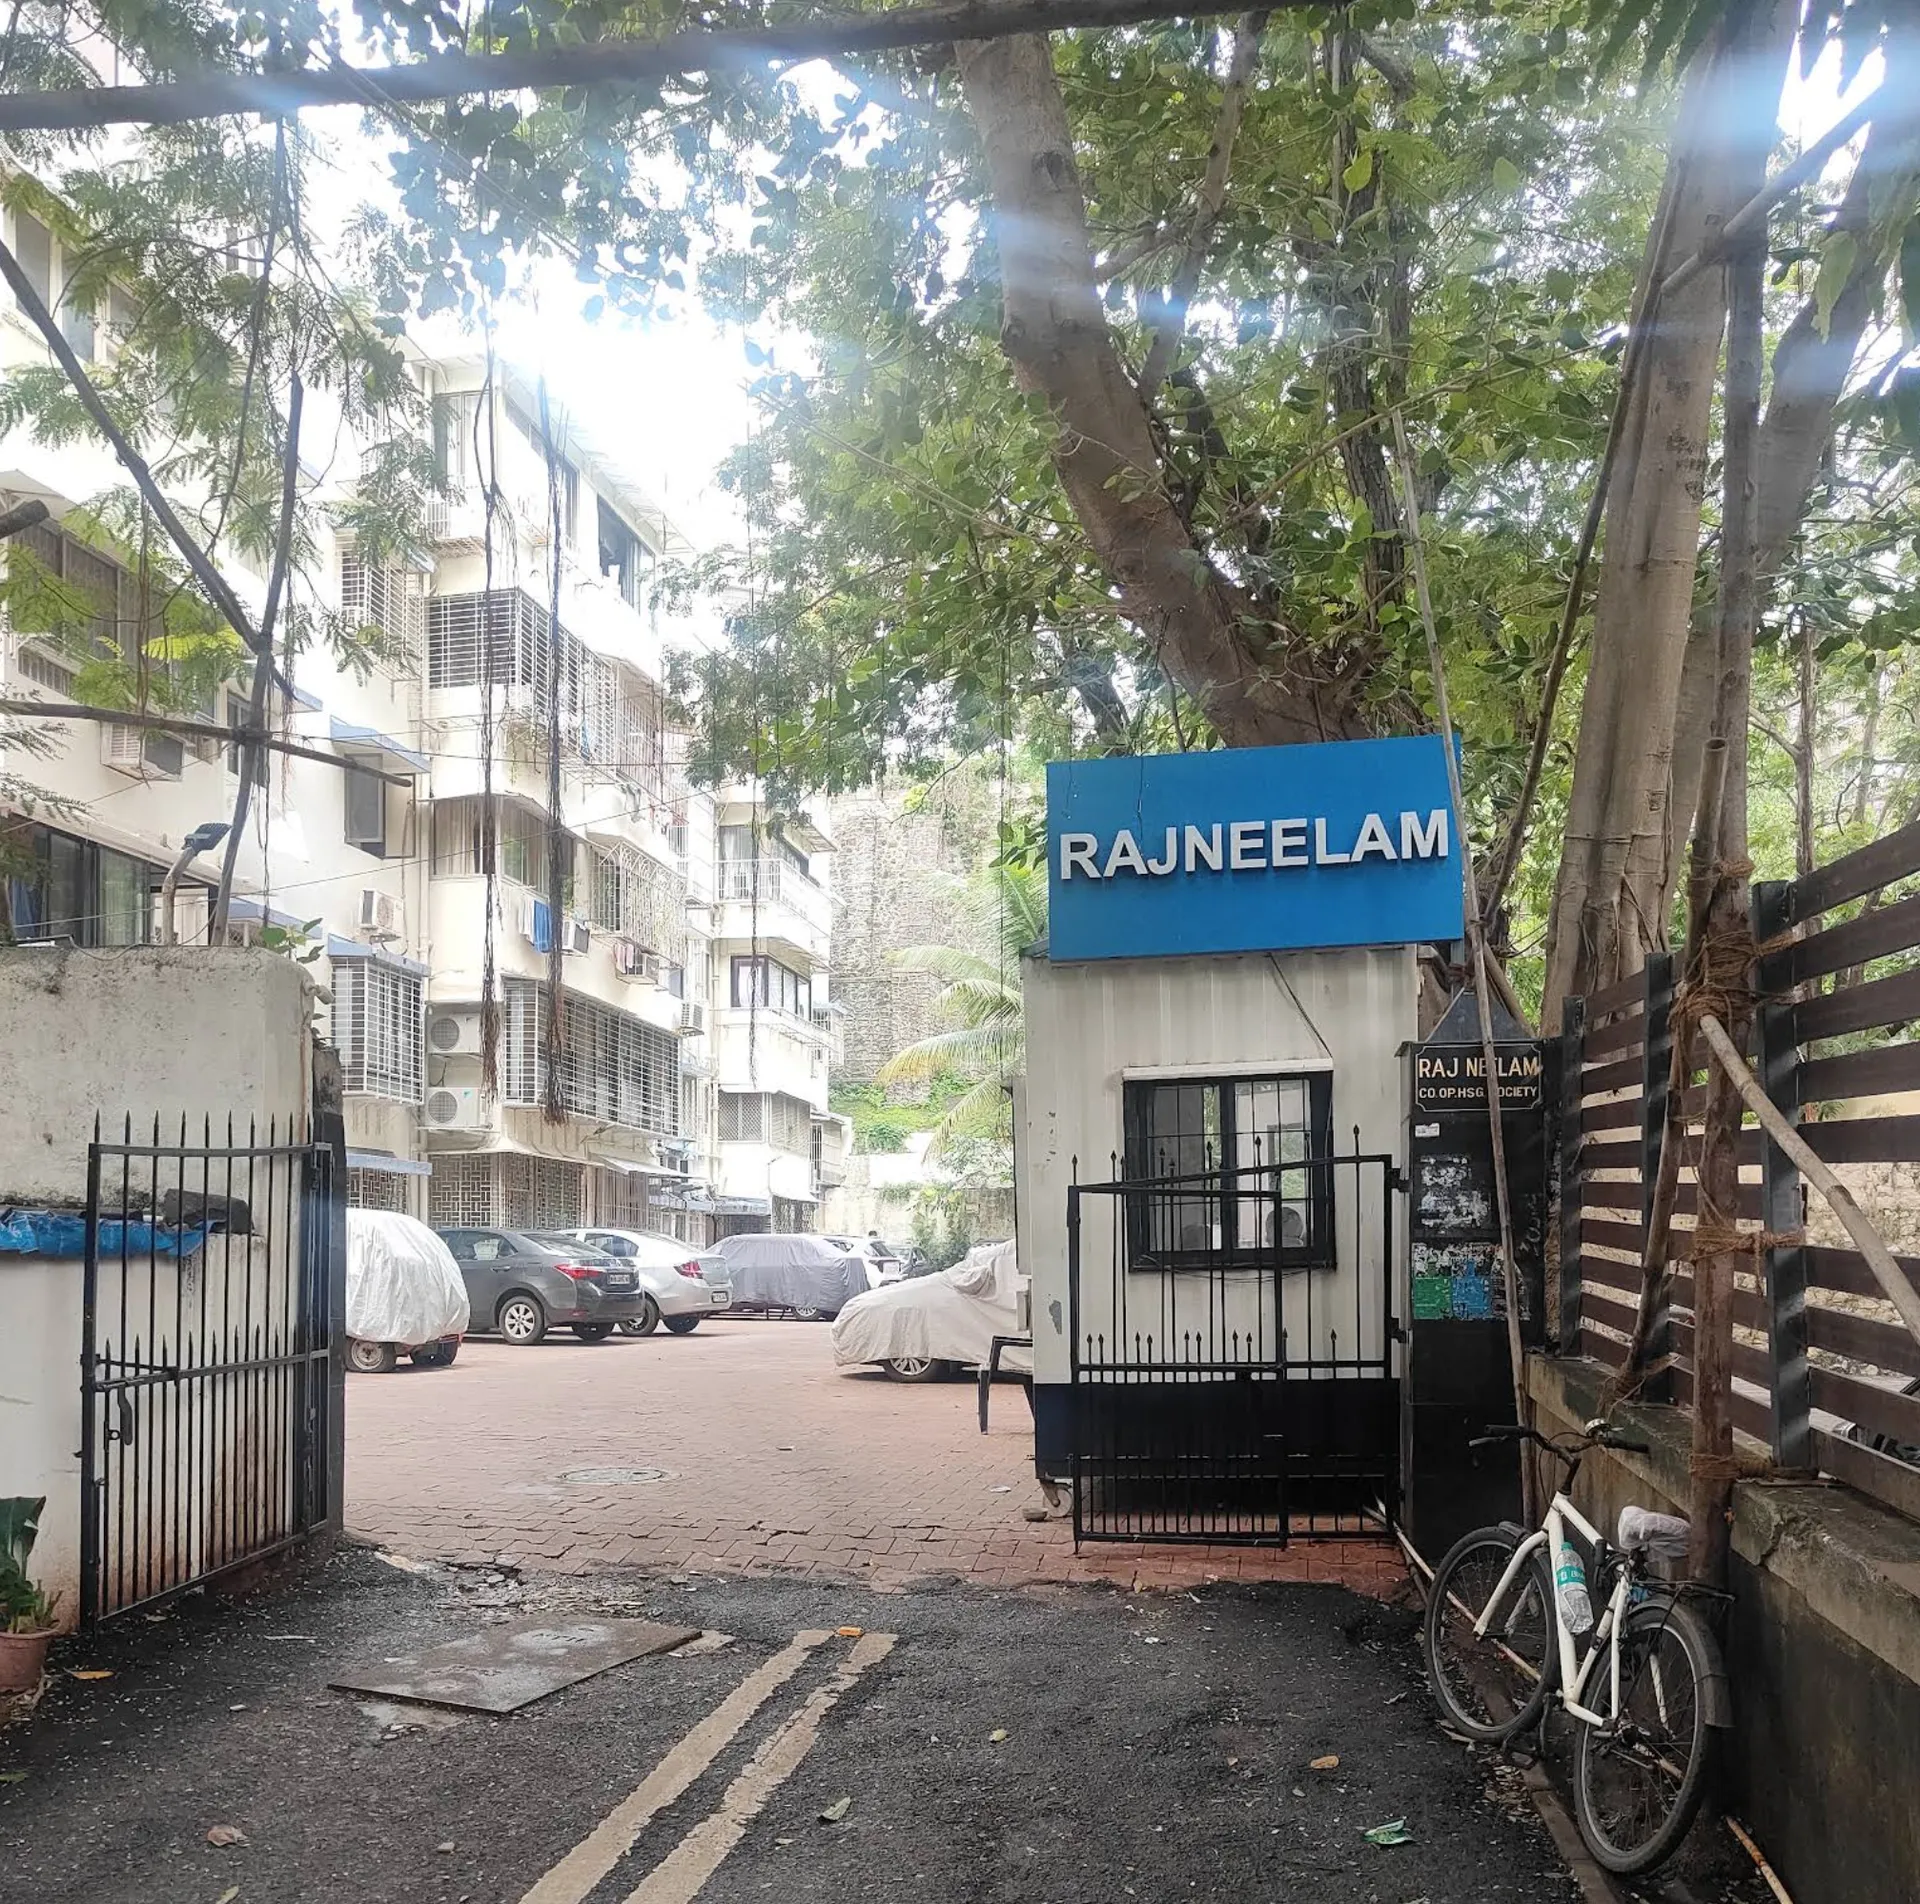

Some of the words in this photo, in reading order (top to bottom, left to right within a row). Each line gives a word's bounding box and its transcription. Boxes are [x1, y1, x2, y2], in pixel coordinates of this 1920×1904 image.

[1060, 808, 1449, 880] RAJNEELAM
[1418, 1057, 1459, 1078] RAJ
[1466, 1056, 1538, 1077] NELAM
[1496, 1086, 1538, 1098] OCIETY
